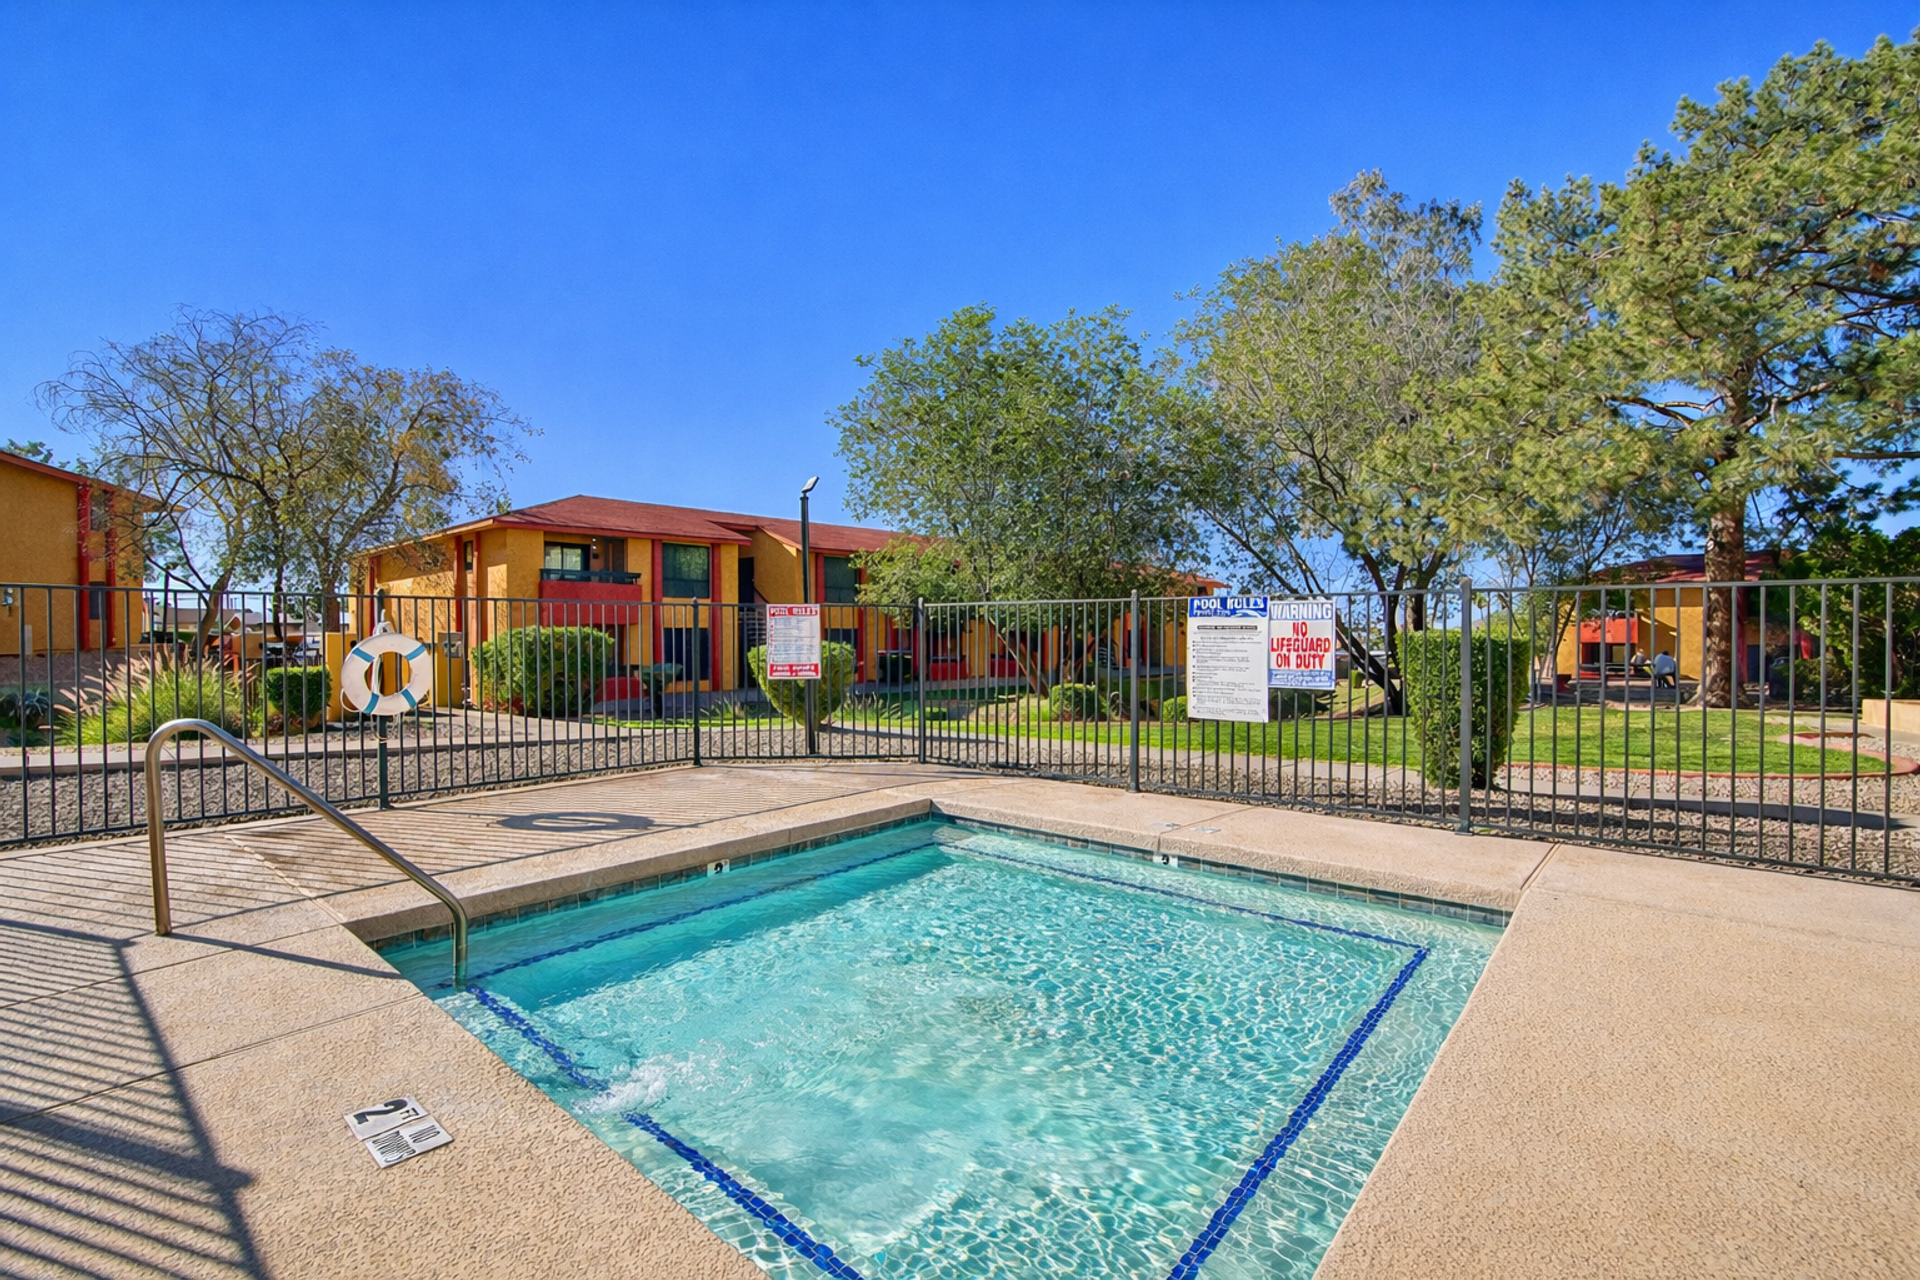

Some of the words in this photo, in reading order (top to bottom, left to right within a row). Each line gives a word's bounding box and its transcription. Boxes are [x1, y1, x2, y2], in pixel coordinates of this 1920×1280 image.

[1270, 603, 1332, 619] WARNING
[1292, 621, 1308, 637] NO
[1270, 637, 1331, 653] LIFEGUARD
[1276, 653, 1291, 669] ON
[1296, 654, 1325, 669] DUTY
[353, 1098, 408, 1125] 2
